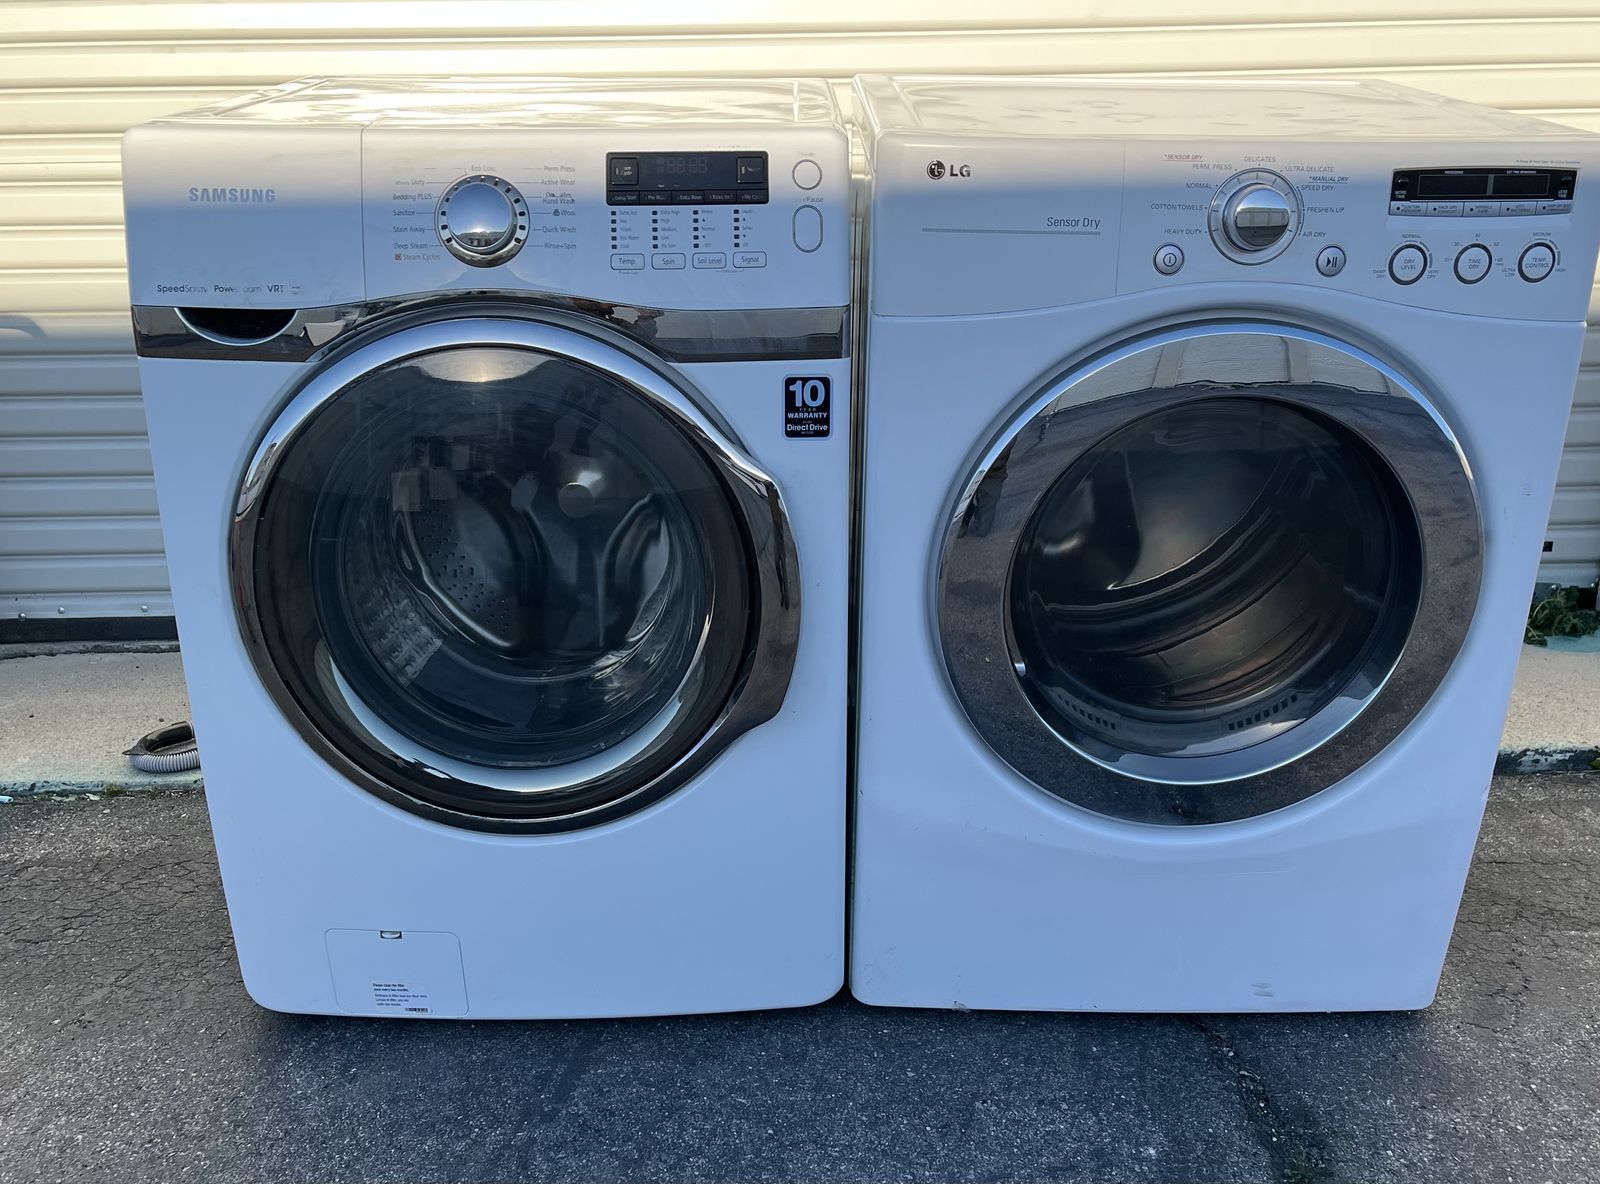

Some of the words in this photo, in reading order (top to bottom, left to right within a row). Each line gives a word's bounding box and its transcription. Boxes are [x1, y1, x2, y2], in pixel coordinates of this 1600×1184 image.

[1243, 155, 1277, 163] DELICATES
[949, 164, 972, 178] LG
[1212, 163, 1233, 171] PRESS
[1285, 165, 1305, 173] ULTRA
[1300, 184, 1321, 192] SPEED
[1321, 184, 1335, 192] DRY
[188, 187, 276, 203] SAMSUNG
[1150, 203, 1204, 211] COTTON/TOWELS
[392, 209, 416, 217] Sanitize
[1046, 216, 1081, 228] Sensor
[1081, 217, 1101, 230] Dry
[409, 226, 426, 234] Away
[542, 225, 559, 233] Quick
[560, 225, 577, 233] Wash
[393, 242, 409, 250] Deep
[403, 253, 423, 261] Steam
[697, 256, 708, 265] Soil
[708, 256, 723, 265] Level
[741, 255, 760, 265] Signal
[661, 257, 676, 266] Spin
[789, 379, 826, 408] 10
[786, 423, 809, 432] Direct
[809, 423, 828, 431] Drive
